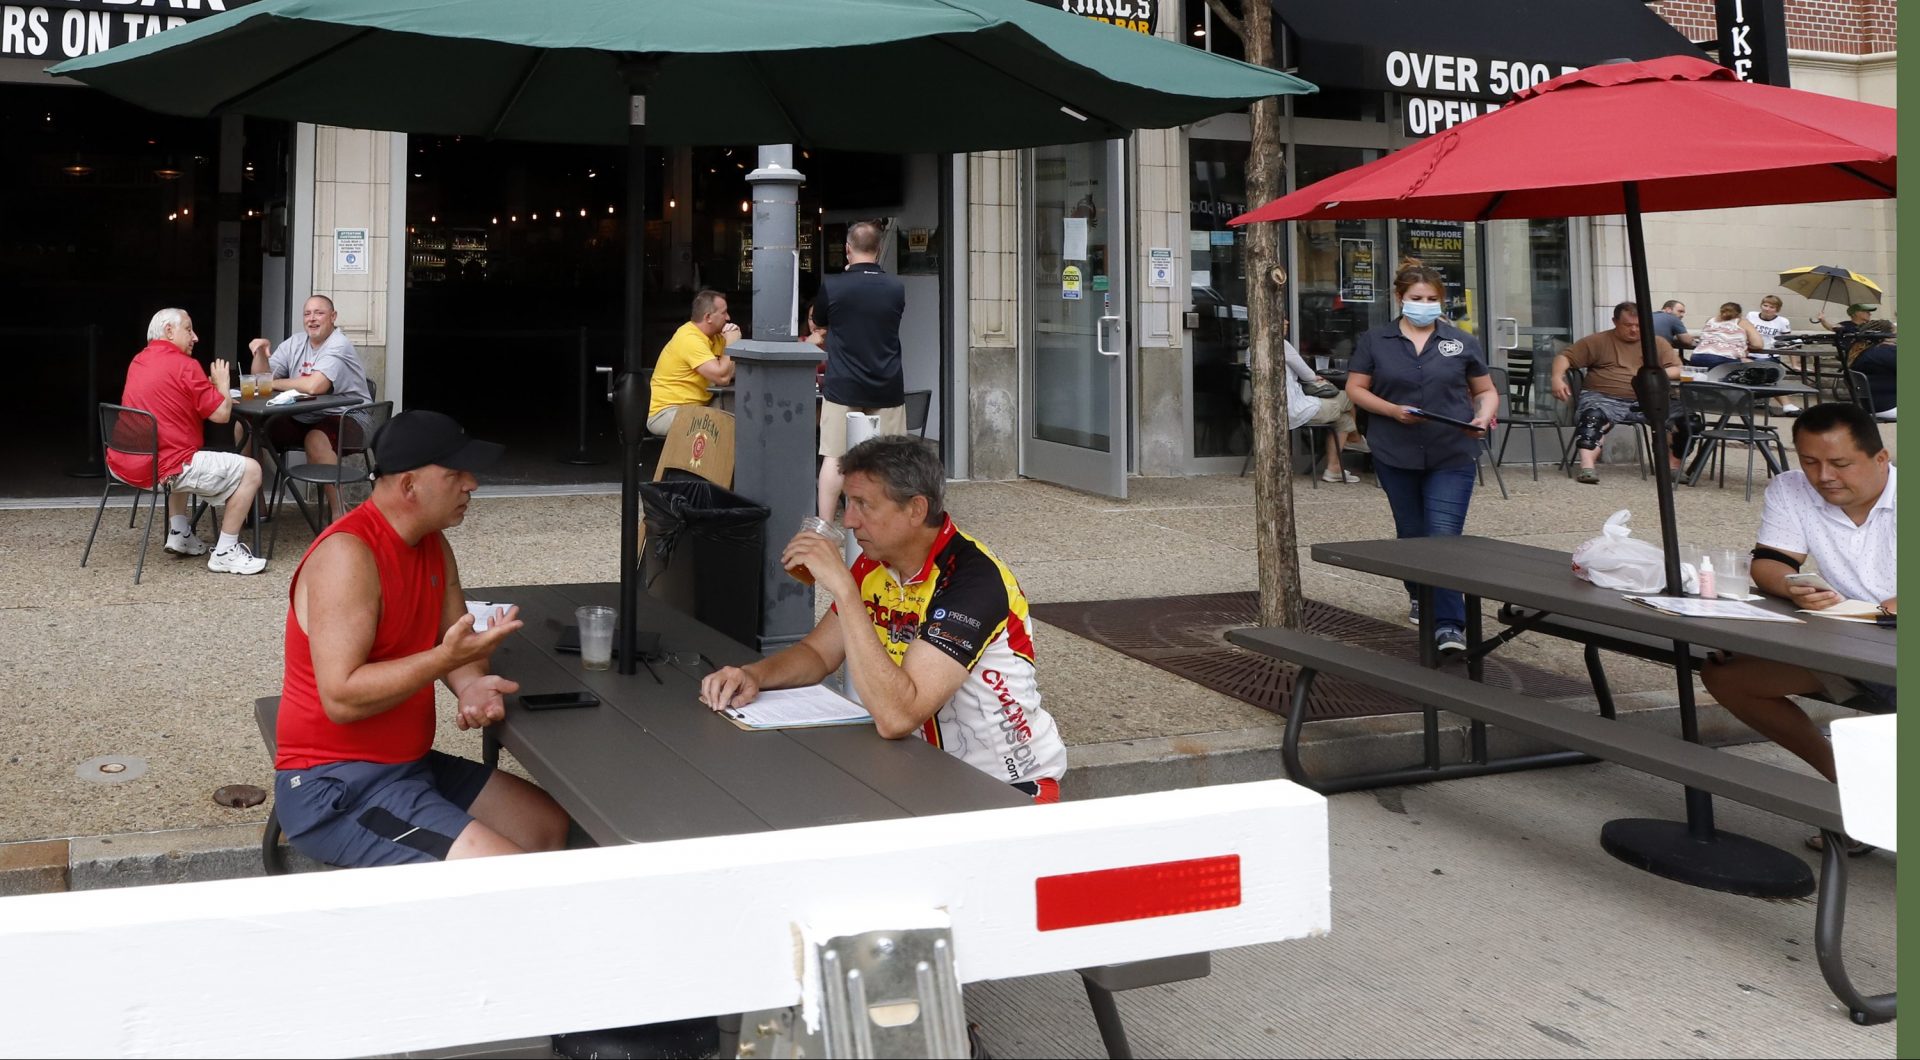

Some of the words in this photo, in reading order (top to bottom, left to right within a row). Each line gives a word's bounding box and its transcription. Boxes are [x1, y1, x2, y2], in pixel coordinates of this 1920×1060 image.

[62, 8, 110, 58] ON
[123, 13, 187, 43] TA
[1385, 50, 1480, 93] OVER
[1489, 60, 1550, 95] 500
[1410, 229, 1435, 237] NORTH
[1436, 230, 1462, 238] SHORE
[1410, 237, 1462, 250] TAVERN
[686, 416, 702, 437] JIM
[702, 413, 719, 444] BEAM
[948, 610, 981, 630] PREMIER
[1003, 755, 1020, 781] .com
